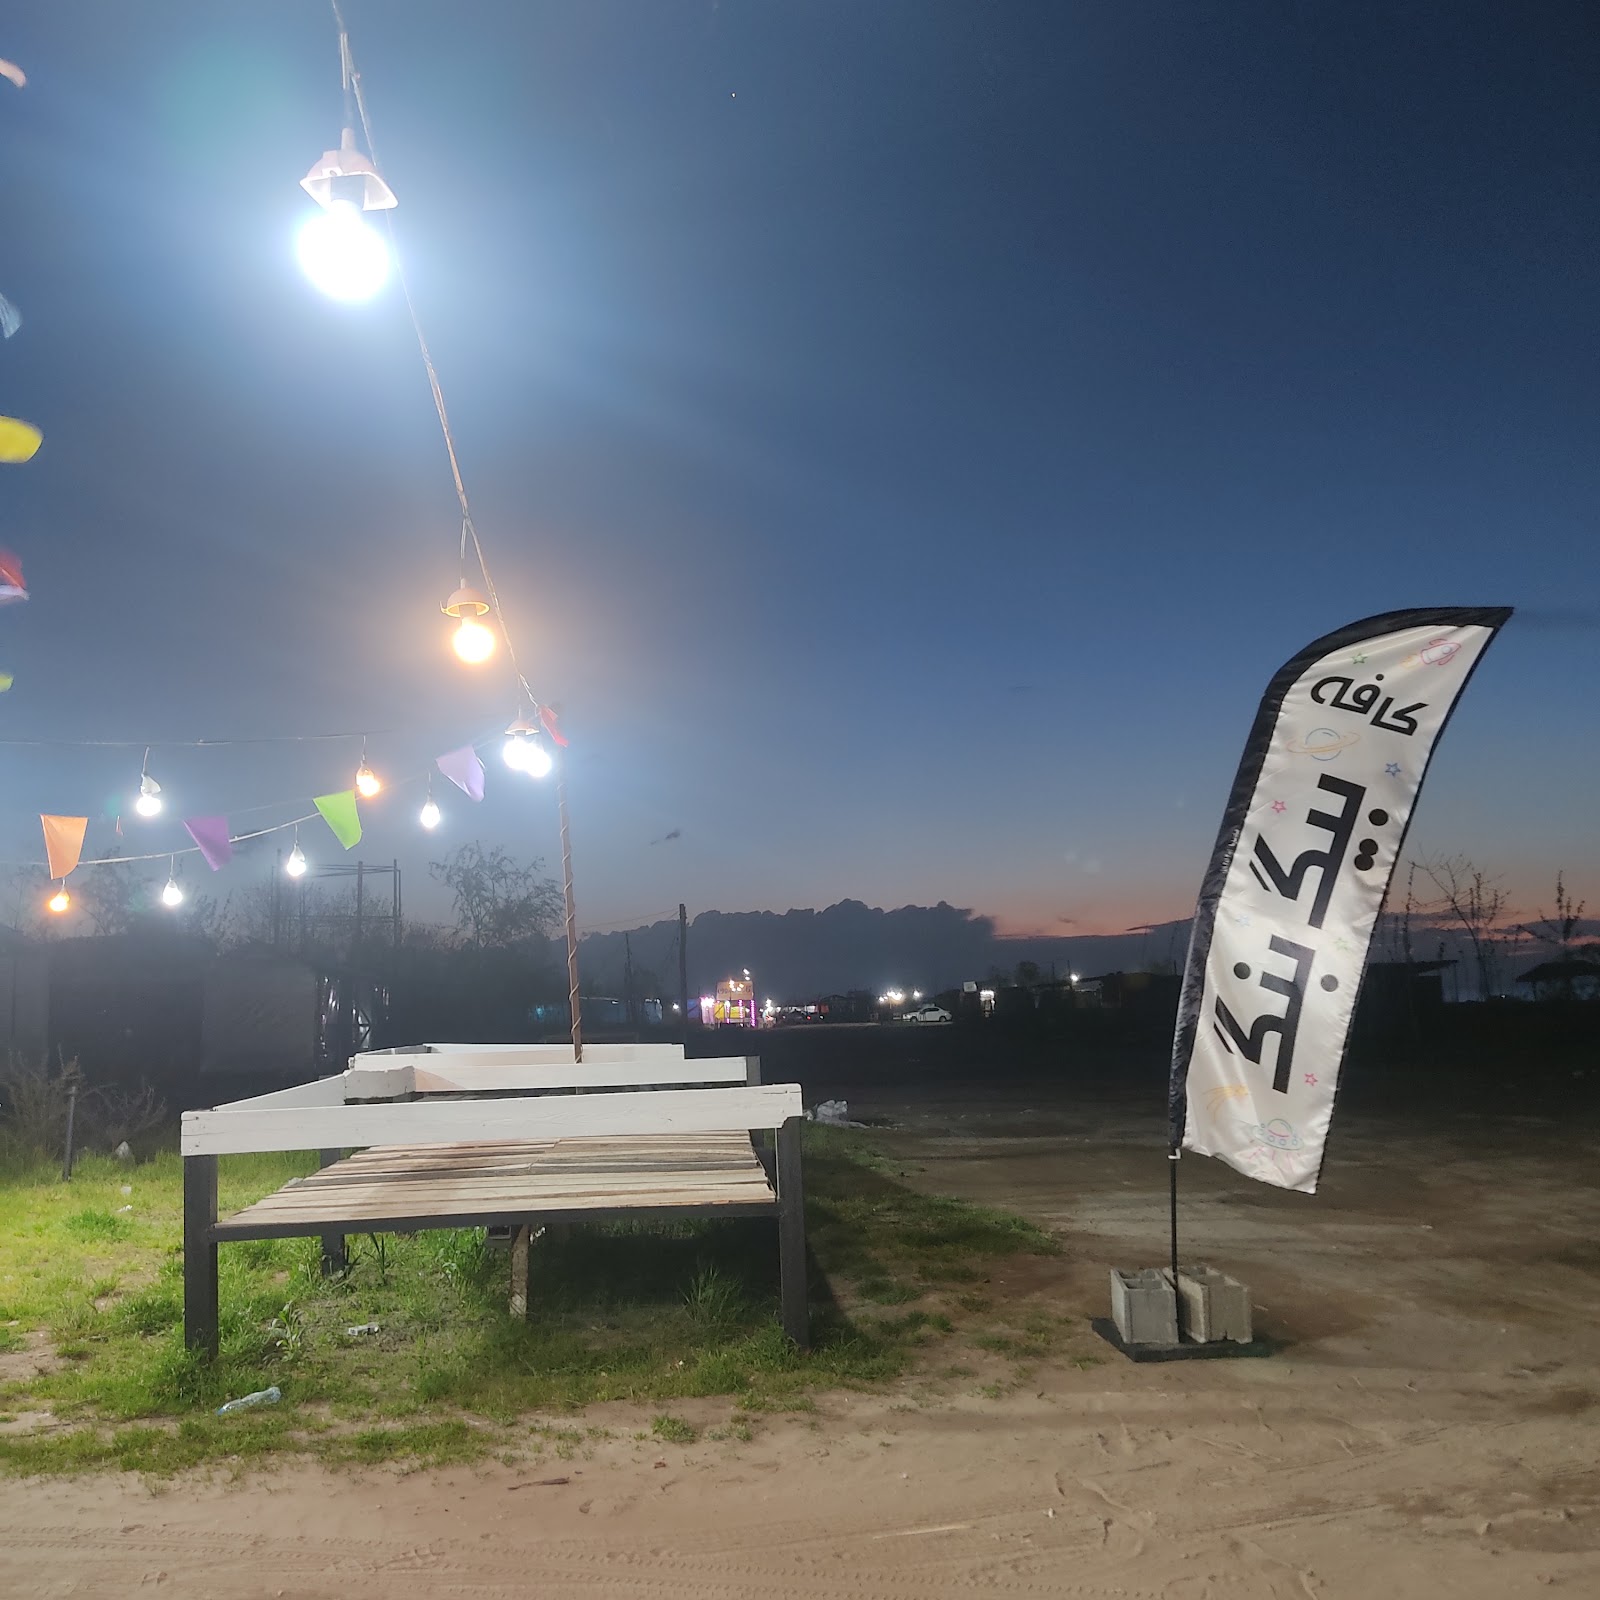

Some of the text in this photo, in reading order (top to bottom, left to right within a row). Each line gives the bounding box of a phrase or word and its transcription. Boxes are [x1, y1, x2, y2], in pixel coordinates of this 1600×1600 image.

[1310, 673, 1430, 736] کافه
[1213, 773, 1389, 1094] بیگ بنگ
